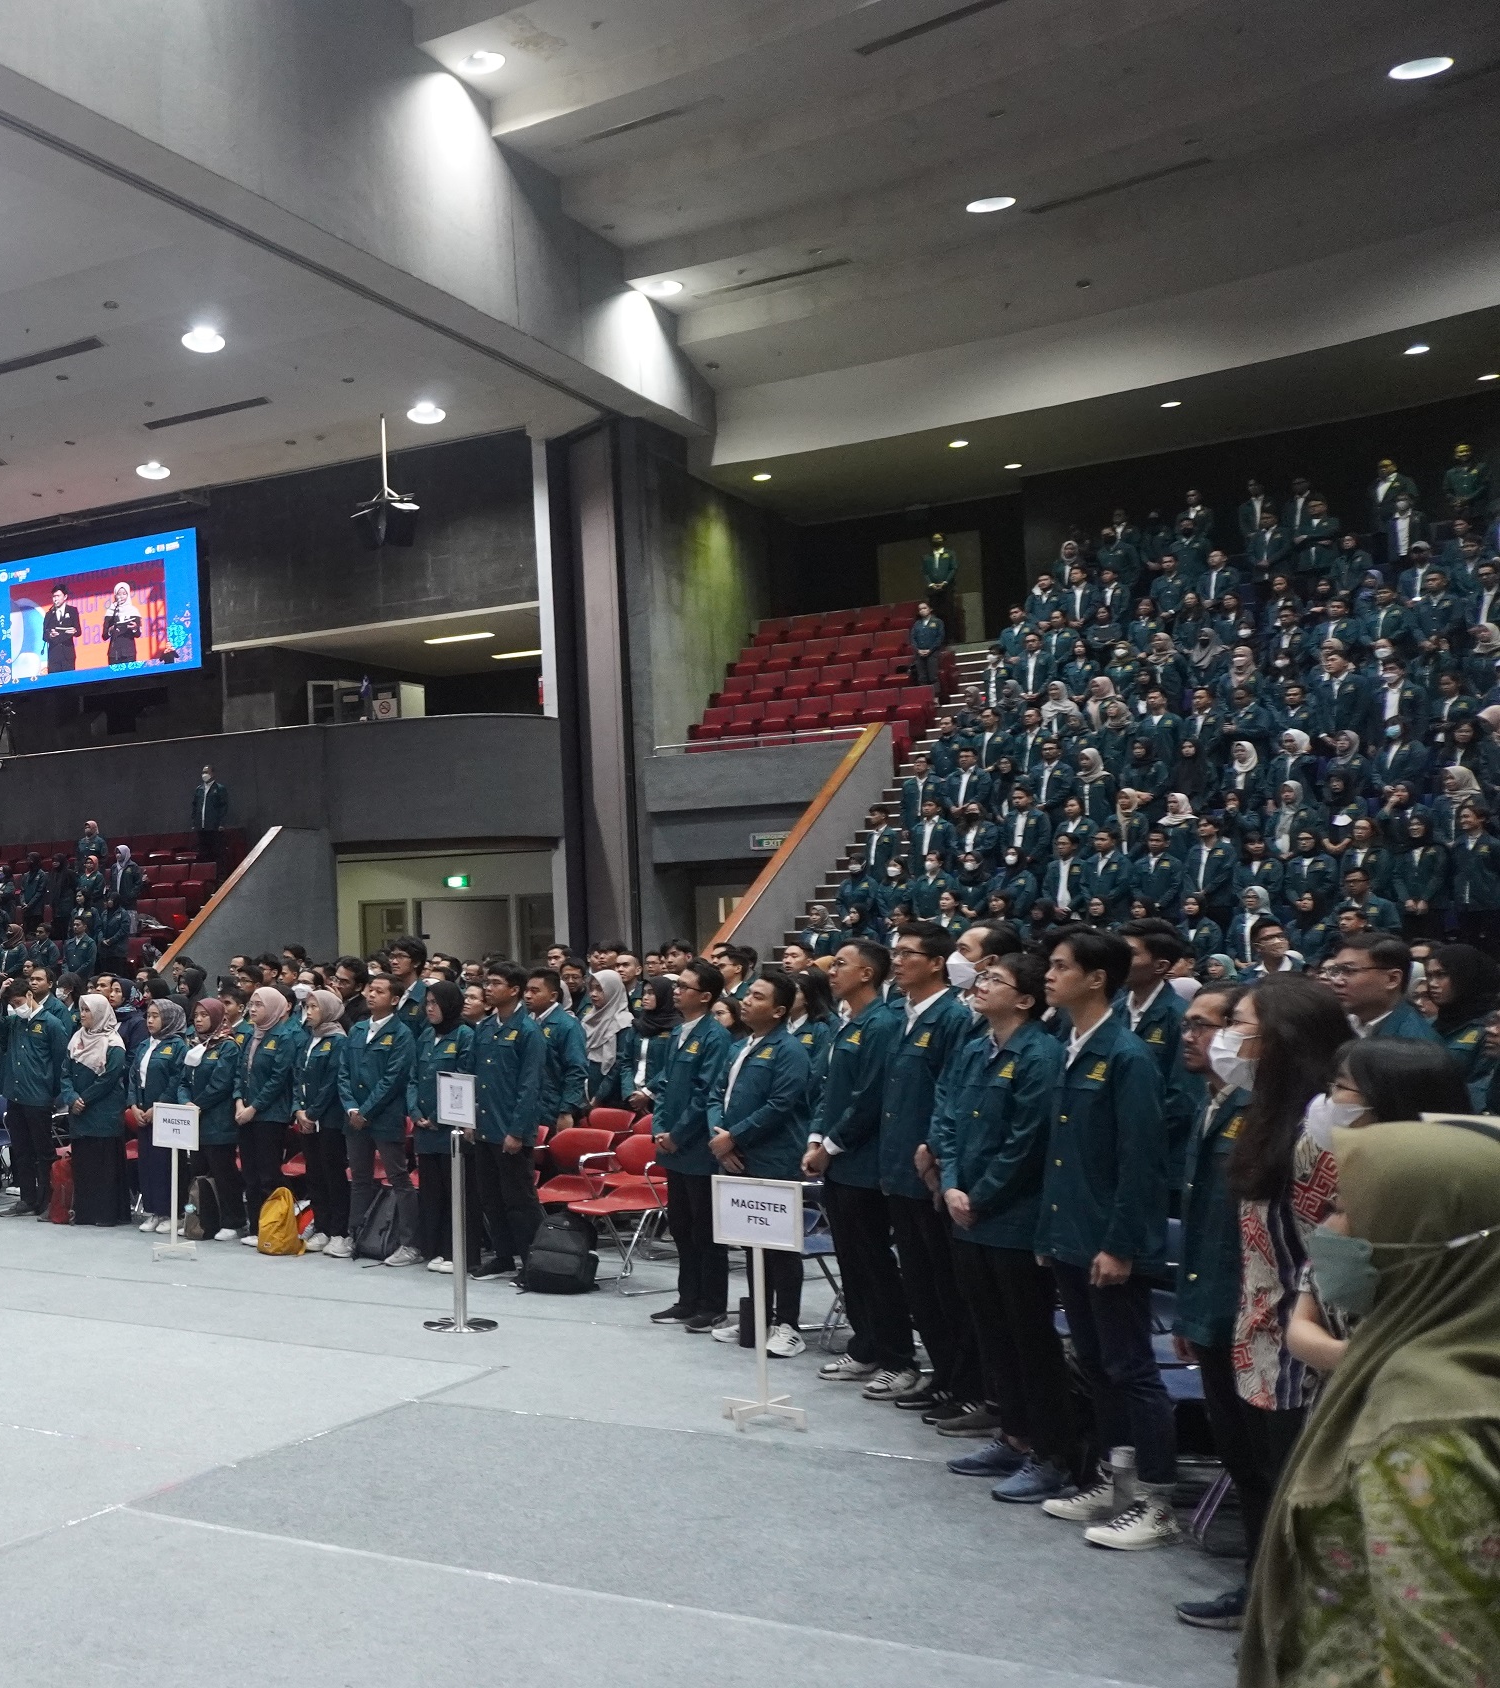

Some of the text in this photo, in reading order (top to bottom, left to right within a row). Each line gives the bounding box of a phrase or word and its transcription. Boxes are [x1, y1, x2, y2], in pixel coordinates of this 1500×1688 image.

[162, 1117, 191, 1126] MAGISTER
[731, 1198, 788, 1214] MAGISTER
[747, 1215, 771, 1226] FTSL
